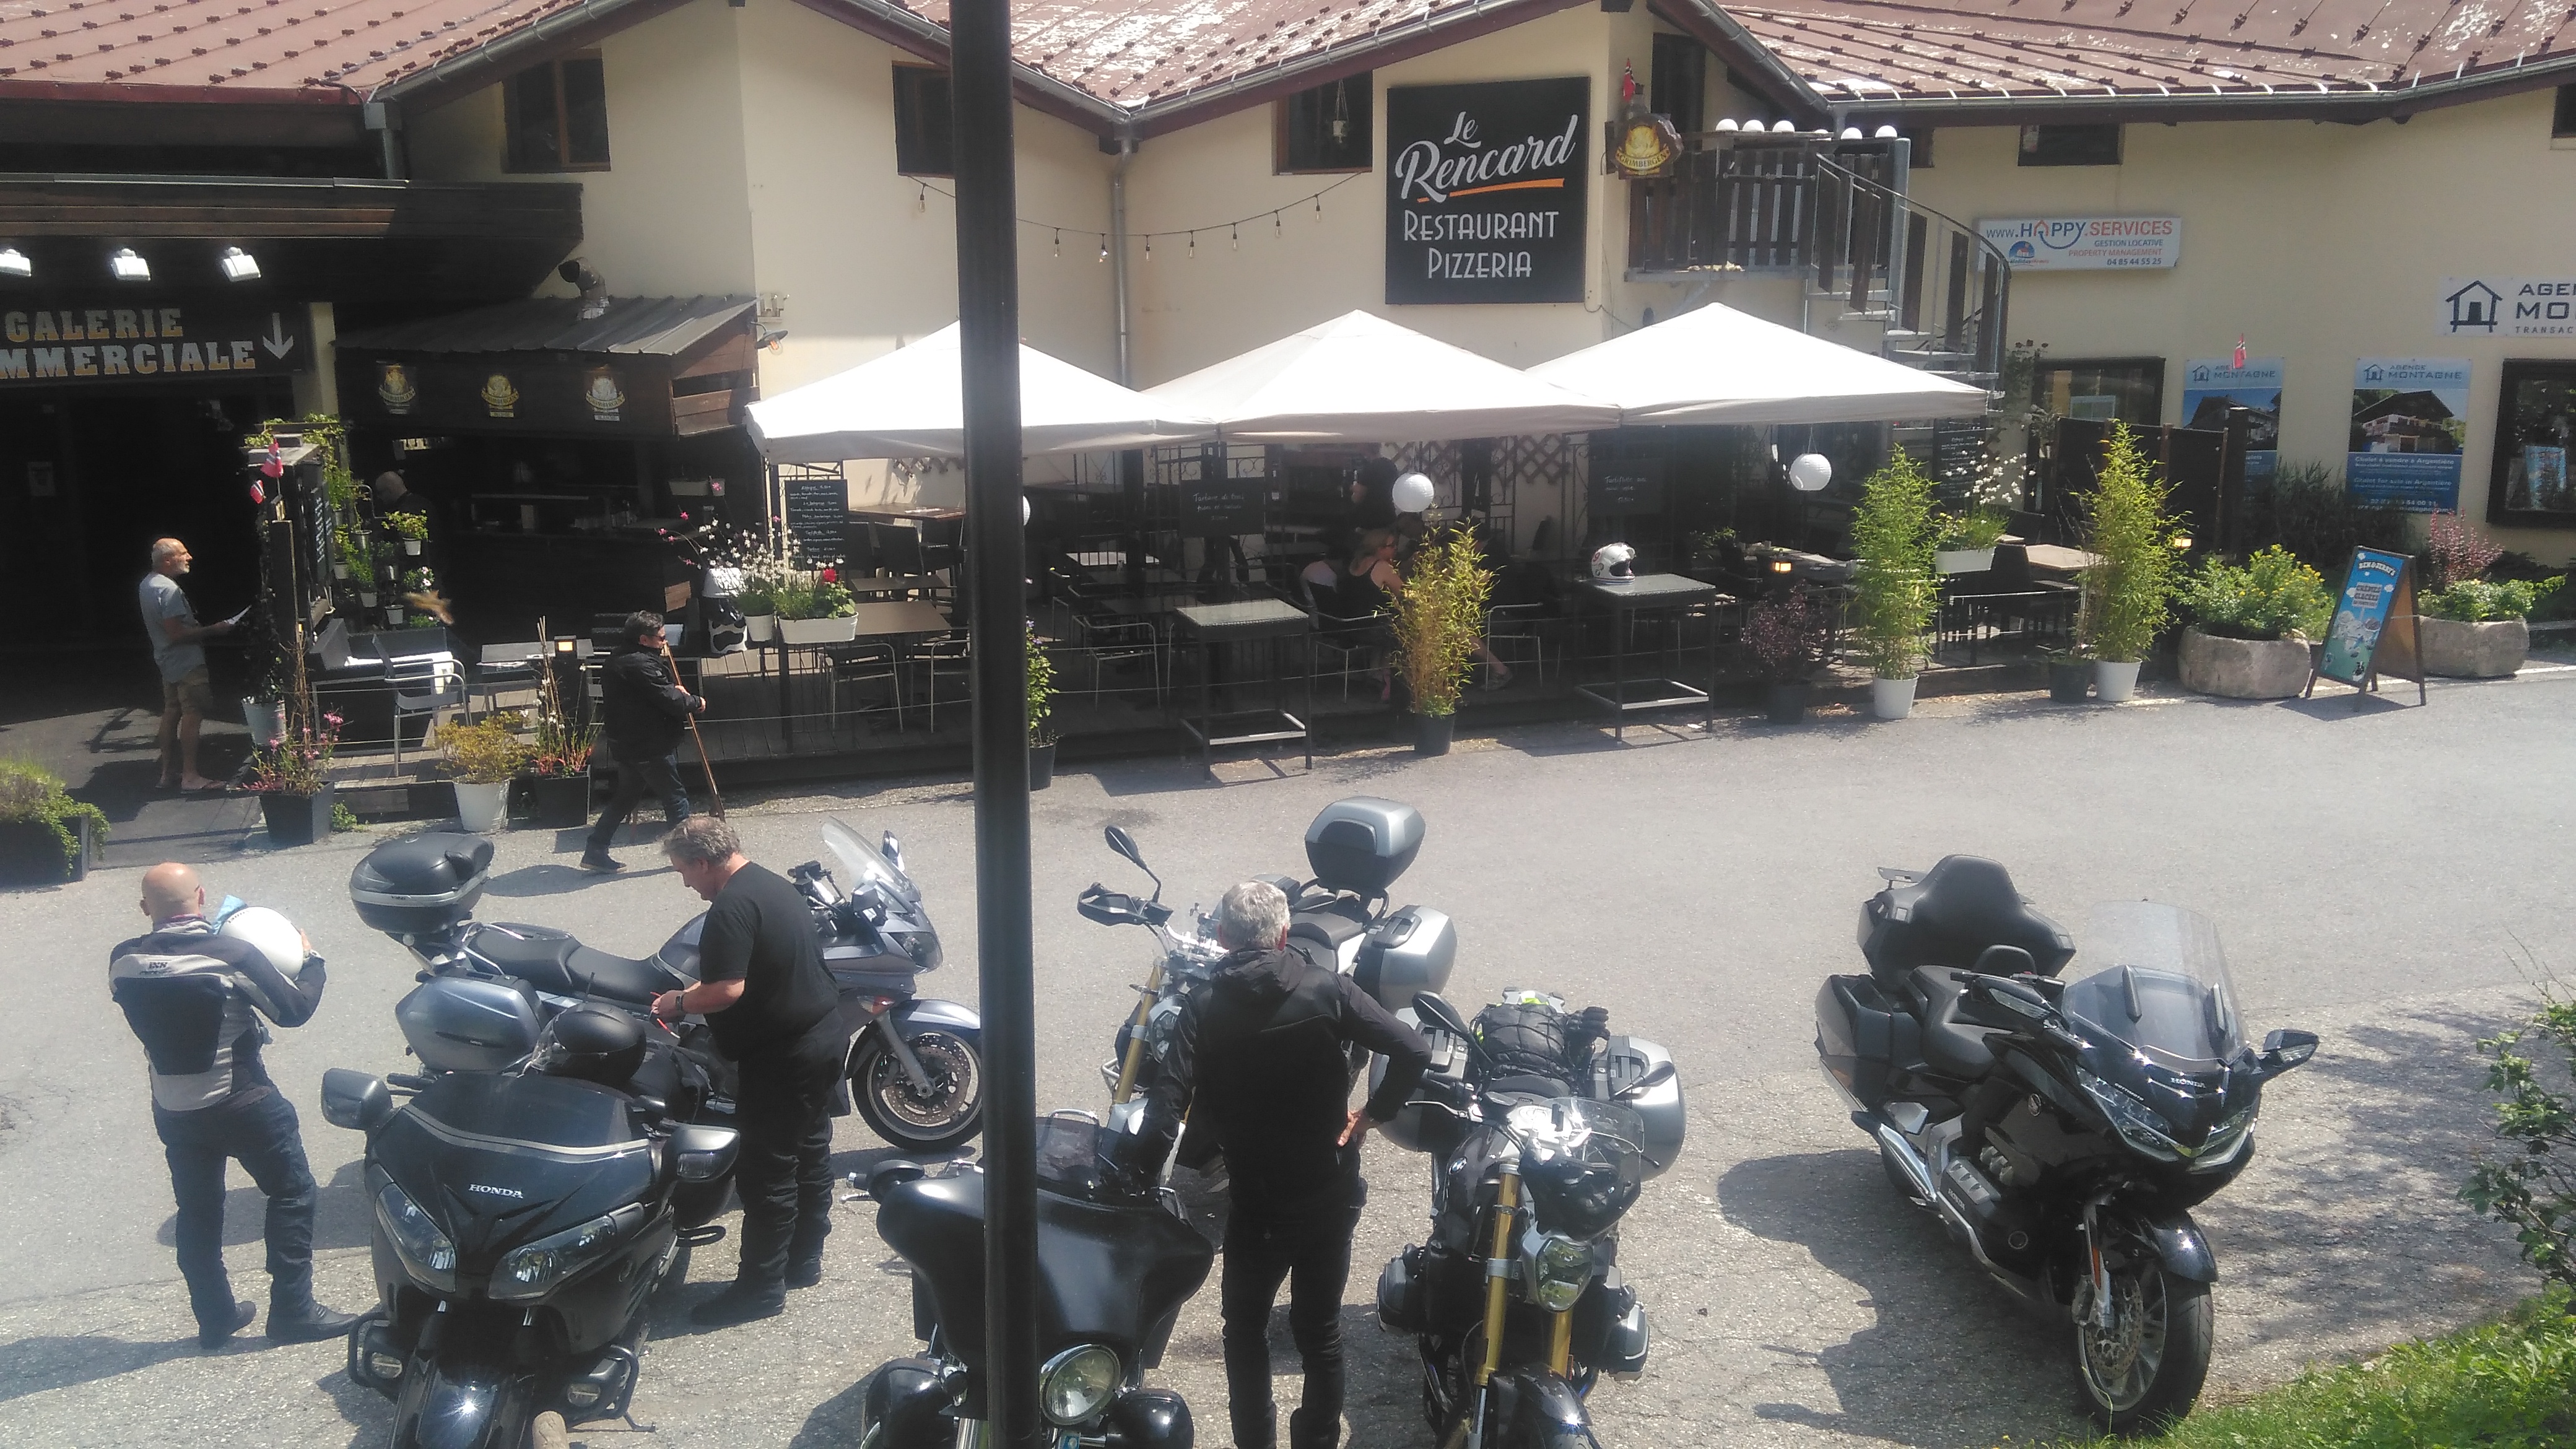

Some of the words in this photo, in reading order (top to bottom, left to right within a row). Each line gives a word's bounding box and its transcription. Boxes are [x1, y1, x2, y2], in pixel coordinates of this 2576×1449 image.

[1443, 111, 1482, 148] Le
[1395, 114, 1579, 203] Rencard
[1619, 154, 1666, 168] GRIMBERGEN
[1404, 209, 1559, 241] RESTAURANT
[1428, 248, 1532, 279] PIZZERIA
[5, 308, 183, 342] GALERIE
[2516, 302, 2576, 319] MO
[2170, 1077, 2206, 1089] HONDA
[468, 1183, 524, 1199] HONDA
